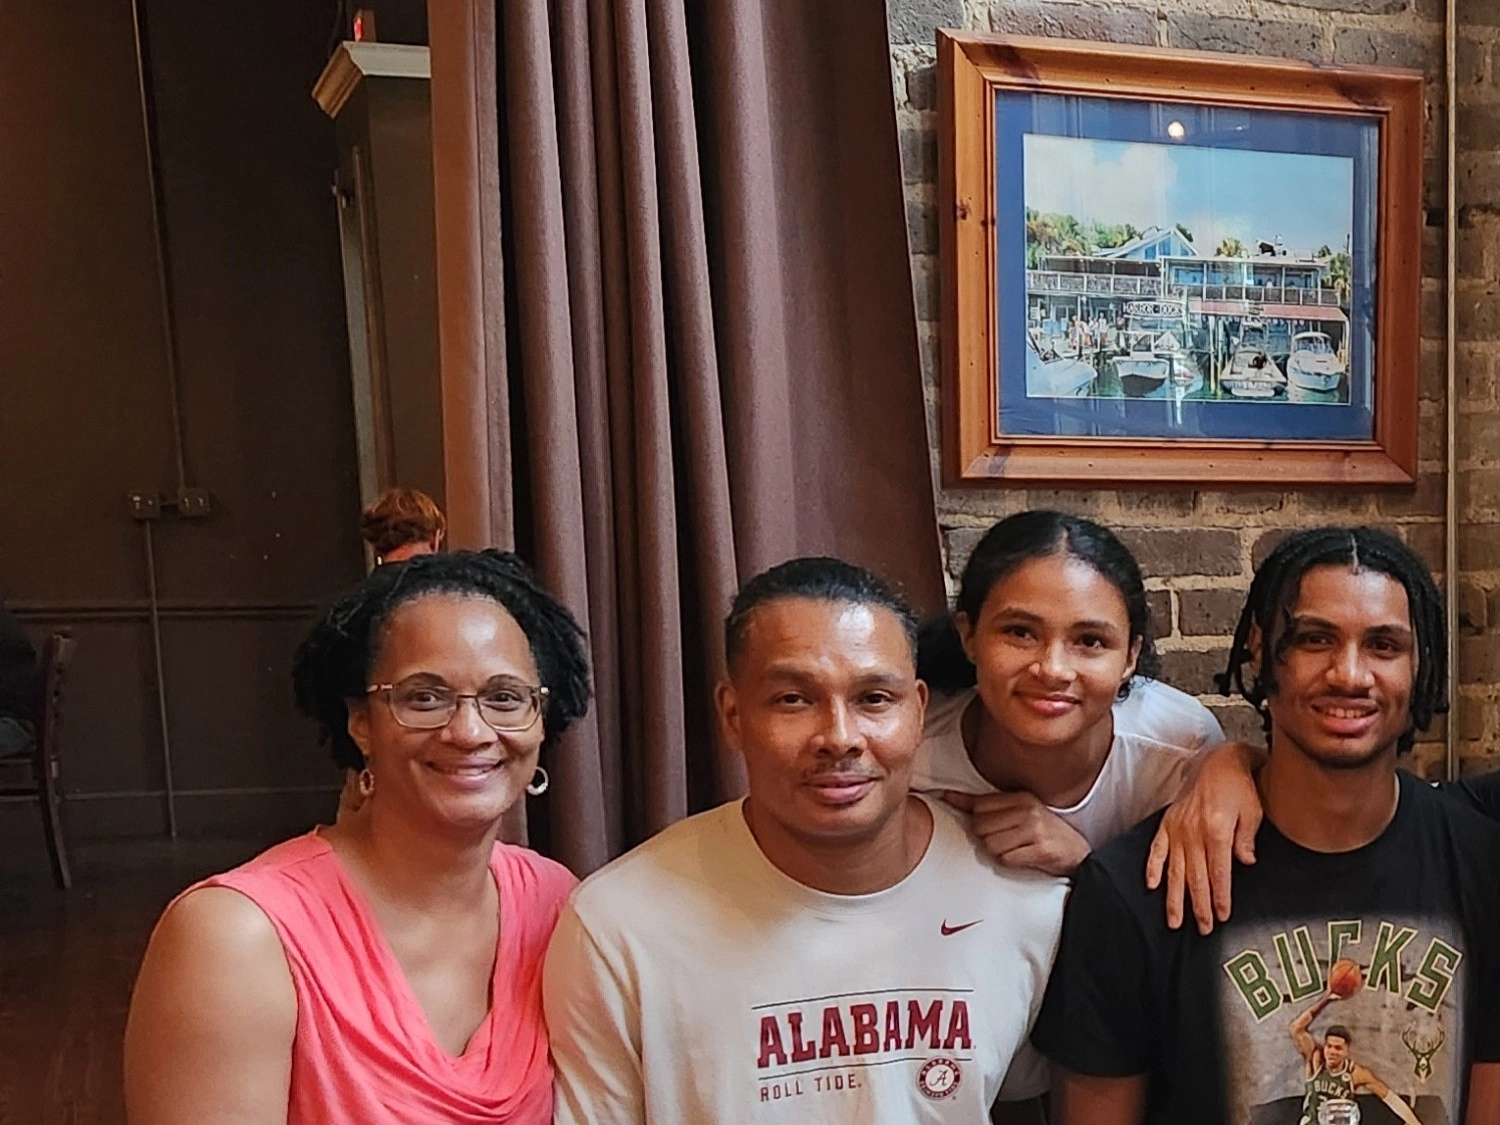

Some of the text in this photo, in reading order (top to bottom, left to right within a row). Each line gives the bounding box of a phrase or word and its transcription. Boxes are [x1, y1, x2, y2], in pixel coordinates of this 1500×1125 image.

[1223, 919, 1463, 1022] BUCKS
[756, 999, 972, 1069] ALABAMA
[760, 1080, 803, 1102] ROLL
[1314, 1080, 1350, 1100] BUCKS
